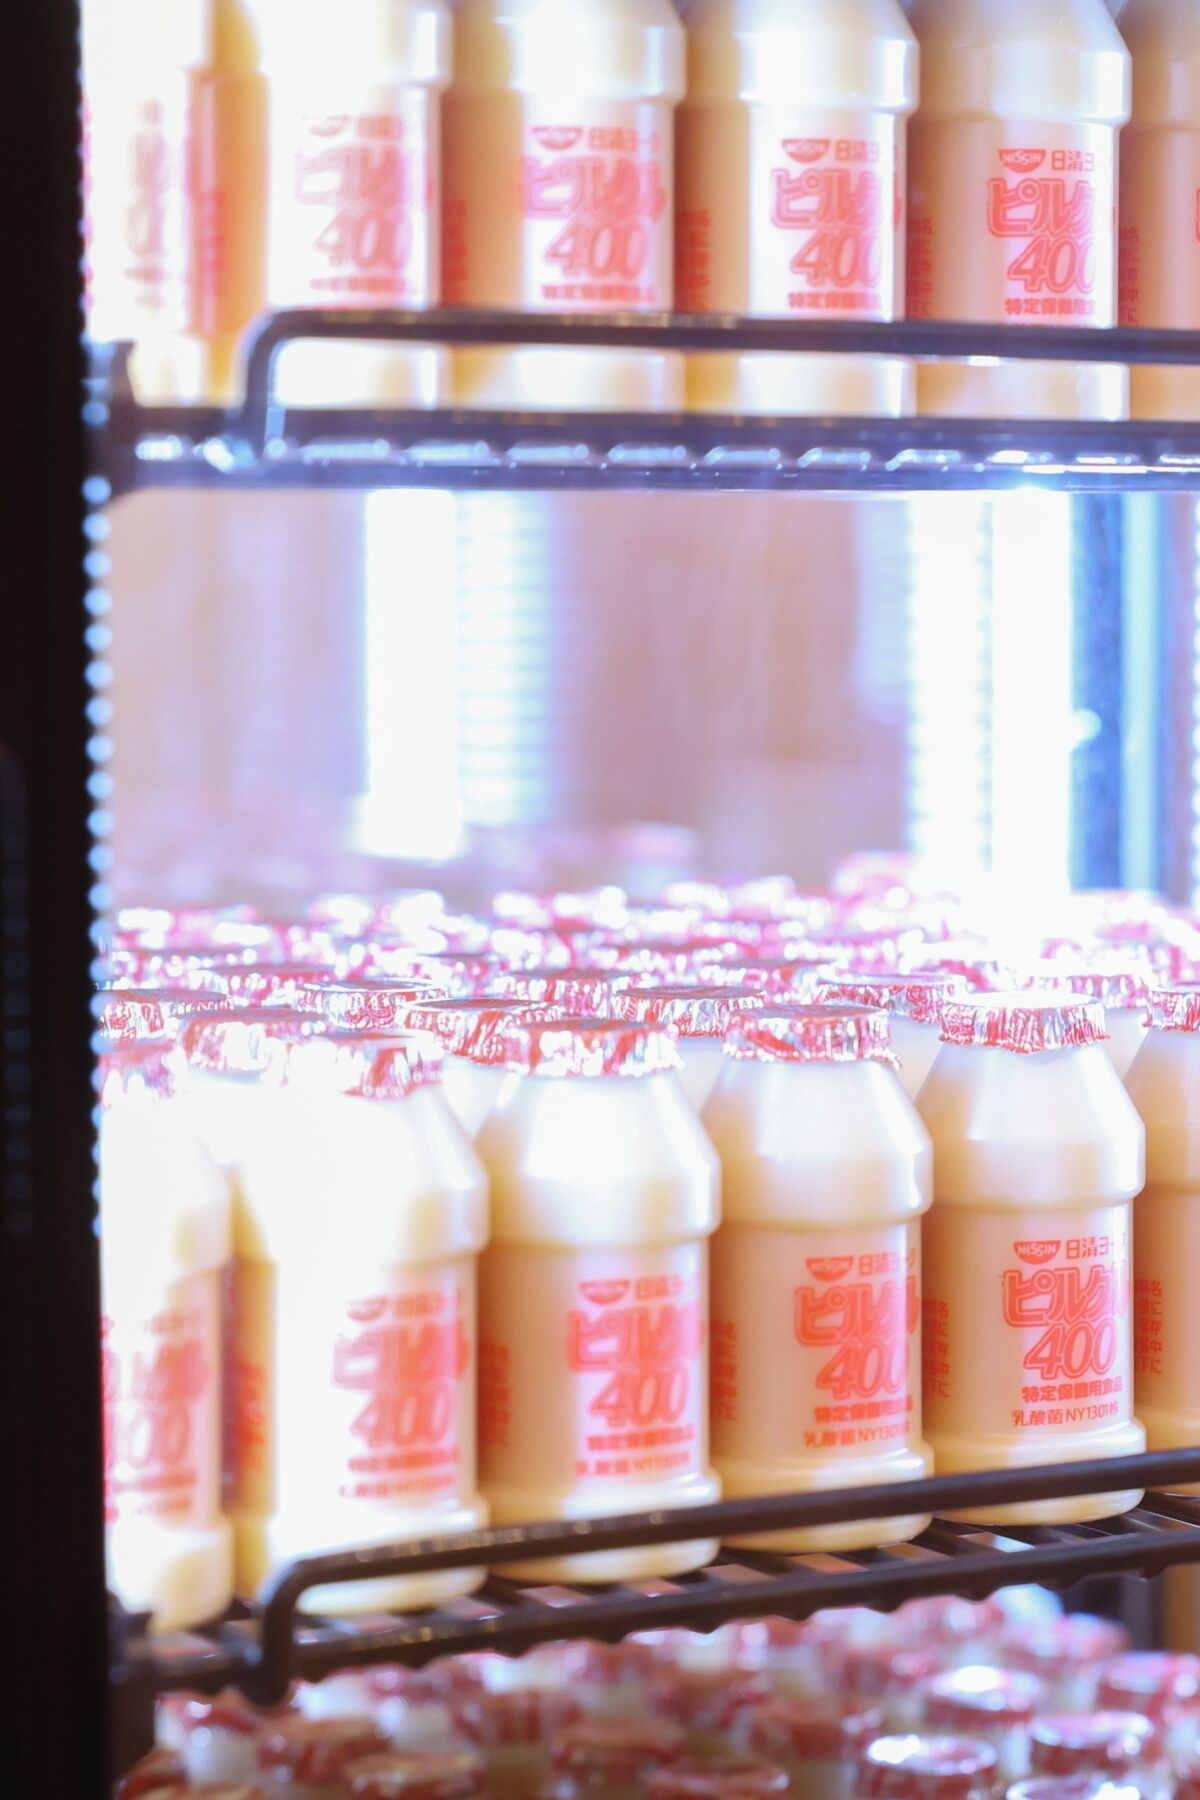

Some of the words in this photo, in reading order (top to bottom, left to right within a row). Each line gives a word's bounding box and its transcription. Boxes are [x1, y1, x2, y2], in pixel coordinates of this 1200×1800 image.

[544, 214, 649, 280] 400
[815, 1338, 908, 1400] 400
[1023, 1317, 1117, 1380] 400
[350, 1382, 452, 1449] 400
[589, 1362, 689, 1427] 400
